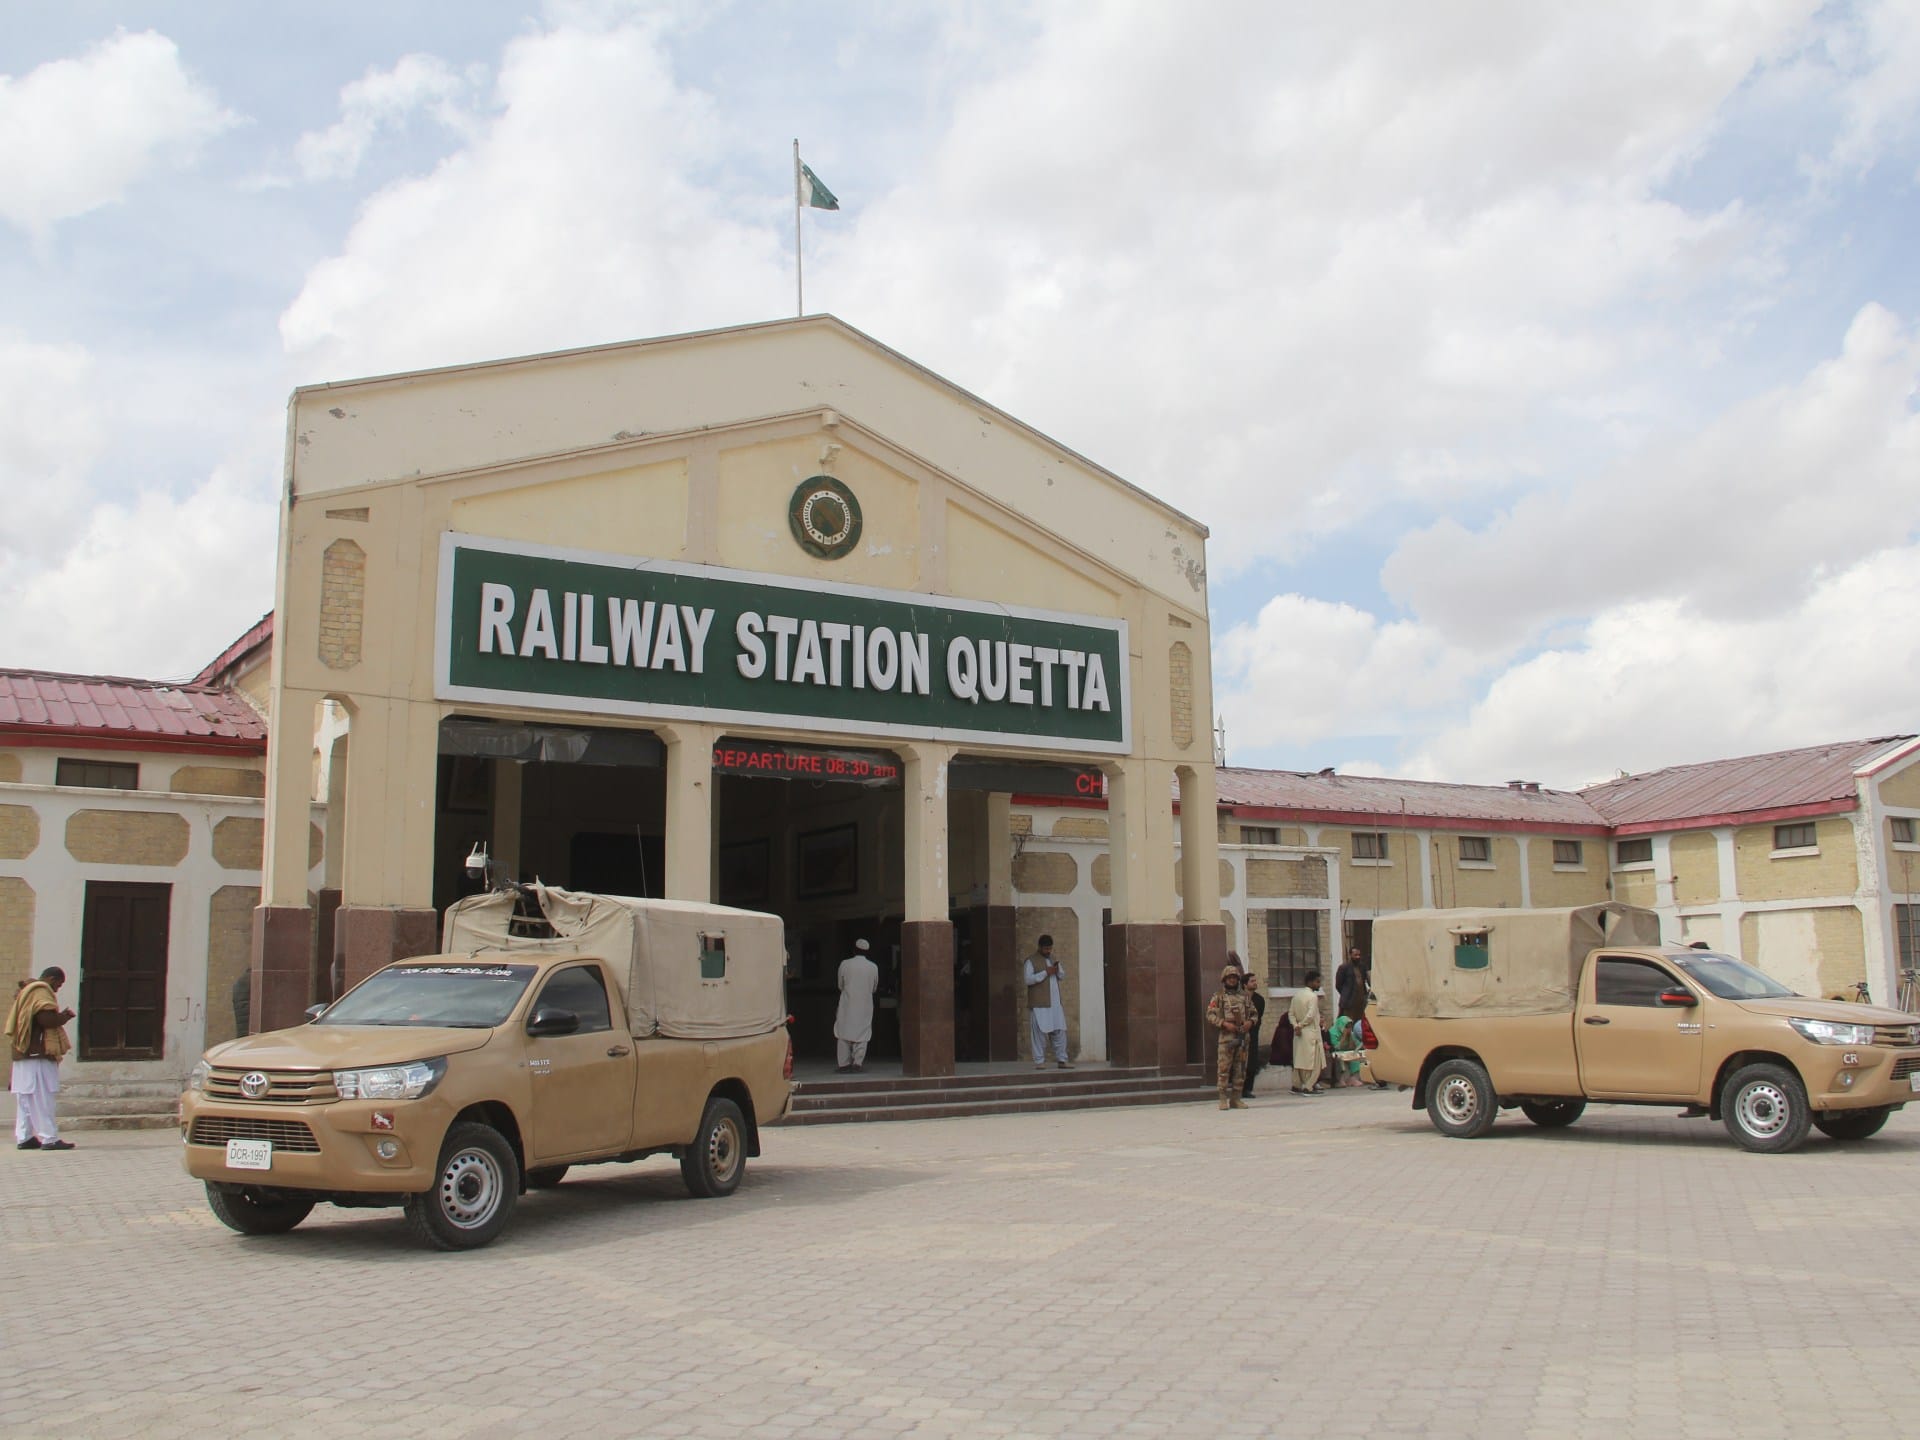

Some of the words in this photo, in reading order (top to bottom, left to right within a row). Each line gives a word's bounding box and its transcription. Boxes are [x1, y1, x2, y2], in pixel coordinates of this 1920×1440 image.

[479, 582, 716, 674] RAILWAY
[735, 611, 930, 695] STATION
[946, 635, 1111, 712] QUETTA
[712, 749, 822, 773] DEPARTURE
[825, 758, 869, 776] 08:30
[872, 763, 897, 778] am
[1843, 1053, 1858, 1065] CR
[230, 1147, 268, 1161] DCR-1997
